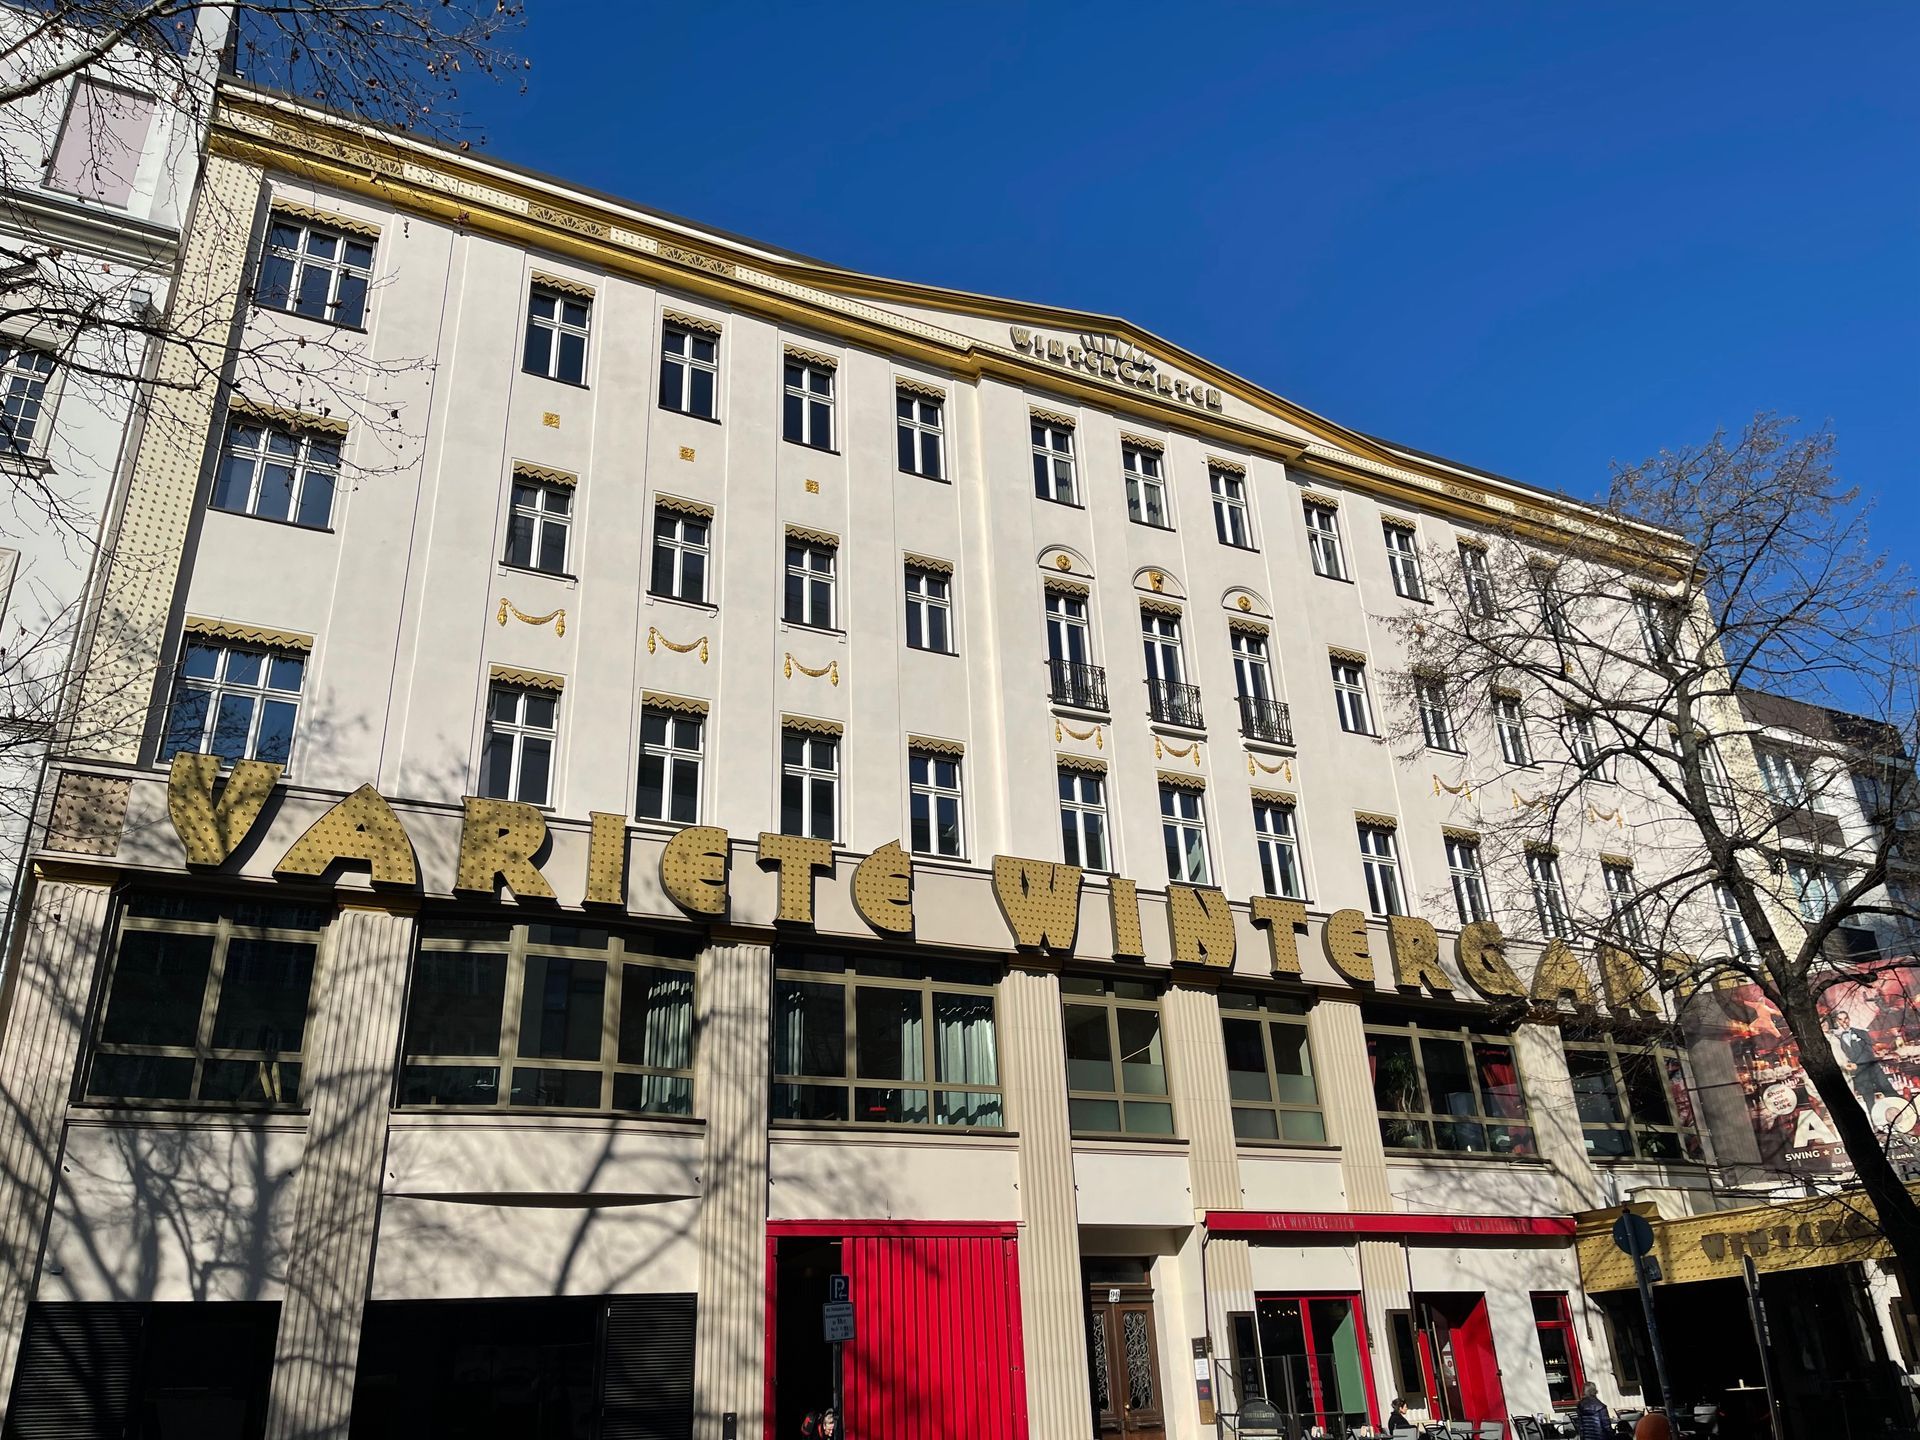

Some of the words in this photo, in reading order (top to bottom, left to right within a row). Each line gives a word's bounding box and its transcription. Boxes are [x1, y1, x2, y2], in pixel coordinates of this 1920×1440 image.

[1010, 326, 1222, 414] WINTERGARTEN
[1785, 1150, 1820, 1162] SWING
[1701, 1211, 1882, 1264] WINTERG
[834, 1278, 845, 1299] P
[1110, 1290, 1120, 1298] 96
